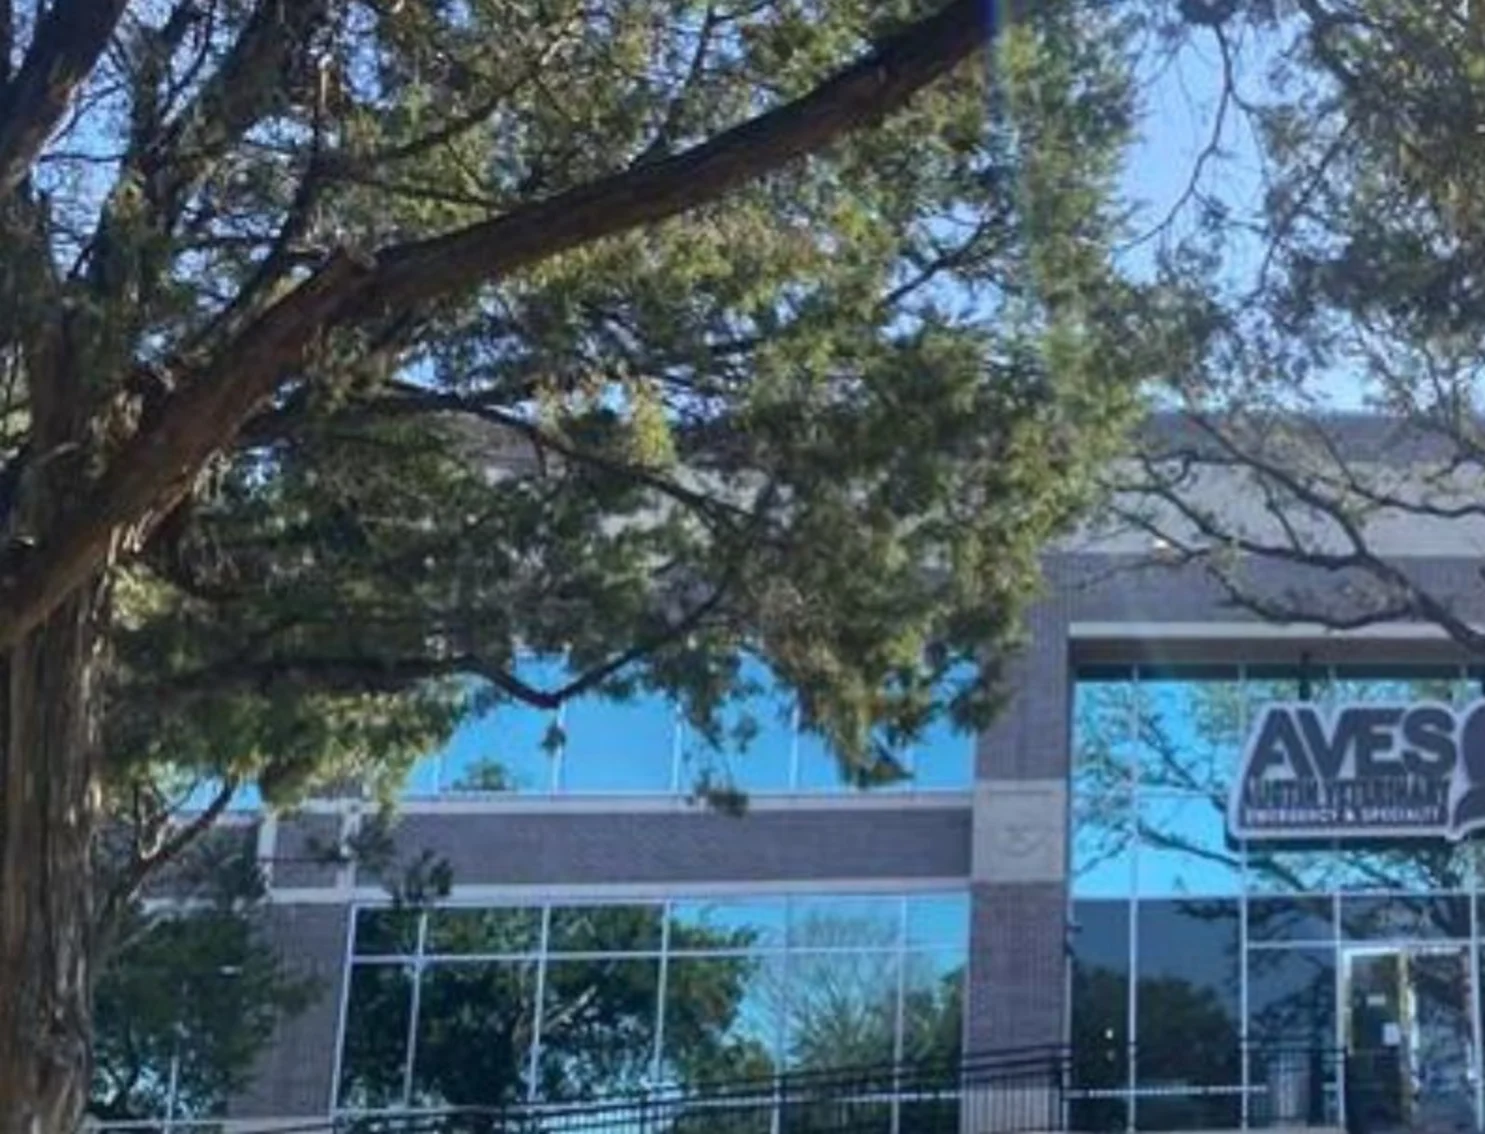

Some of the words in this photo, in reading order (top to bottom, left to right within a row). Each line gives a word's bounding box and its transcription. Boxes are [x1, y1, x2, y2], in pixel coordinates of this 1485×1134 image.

[1251, 706, 1458, 778] AVES
[1246, 807, 1337, 823] EMERGENCY
[1345, 807, 1357, 822] &
[1361, 805, 1440, 822] SPECIALTY
